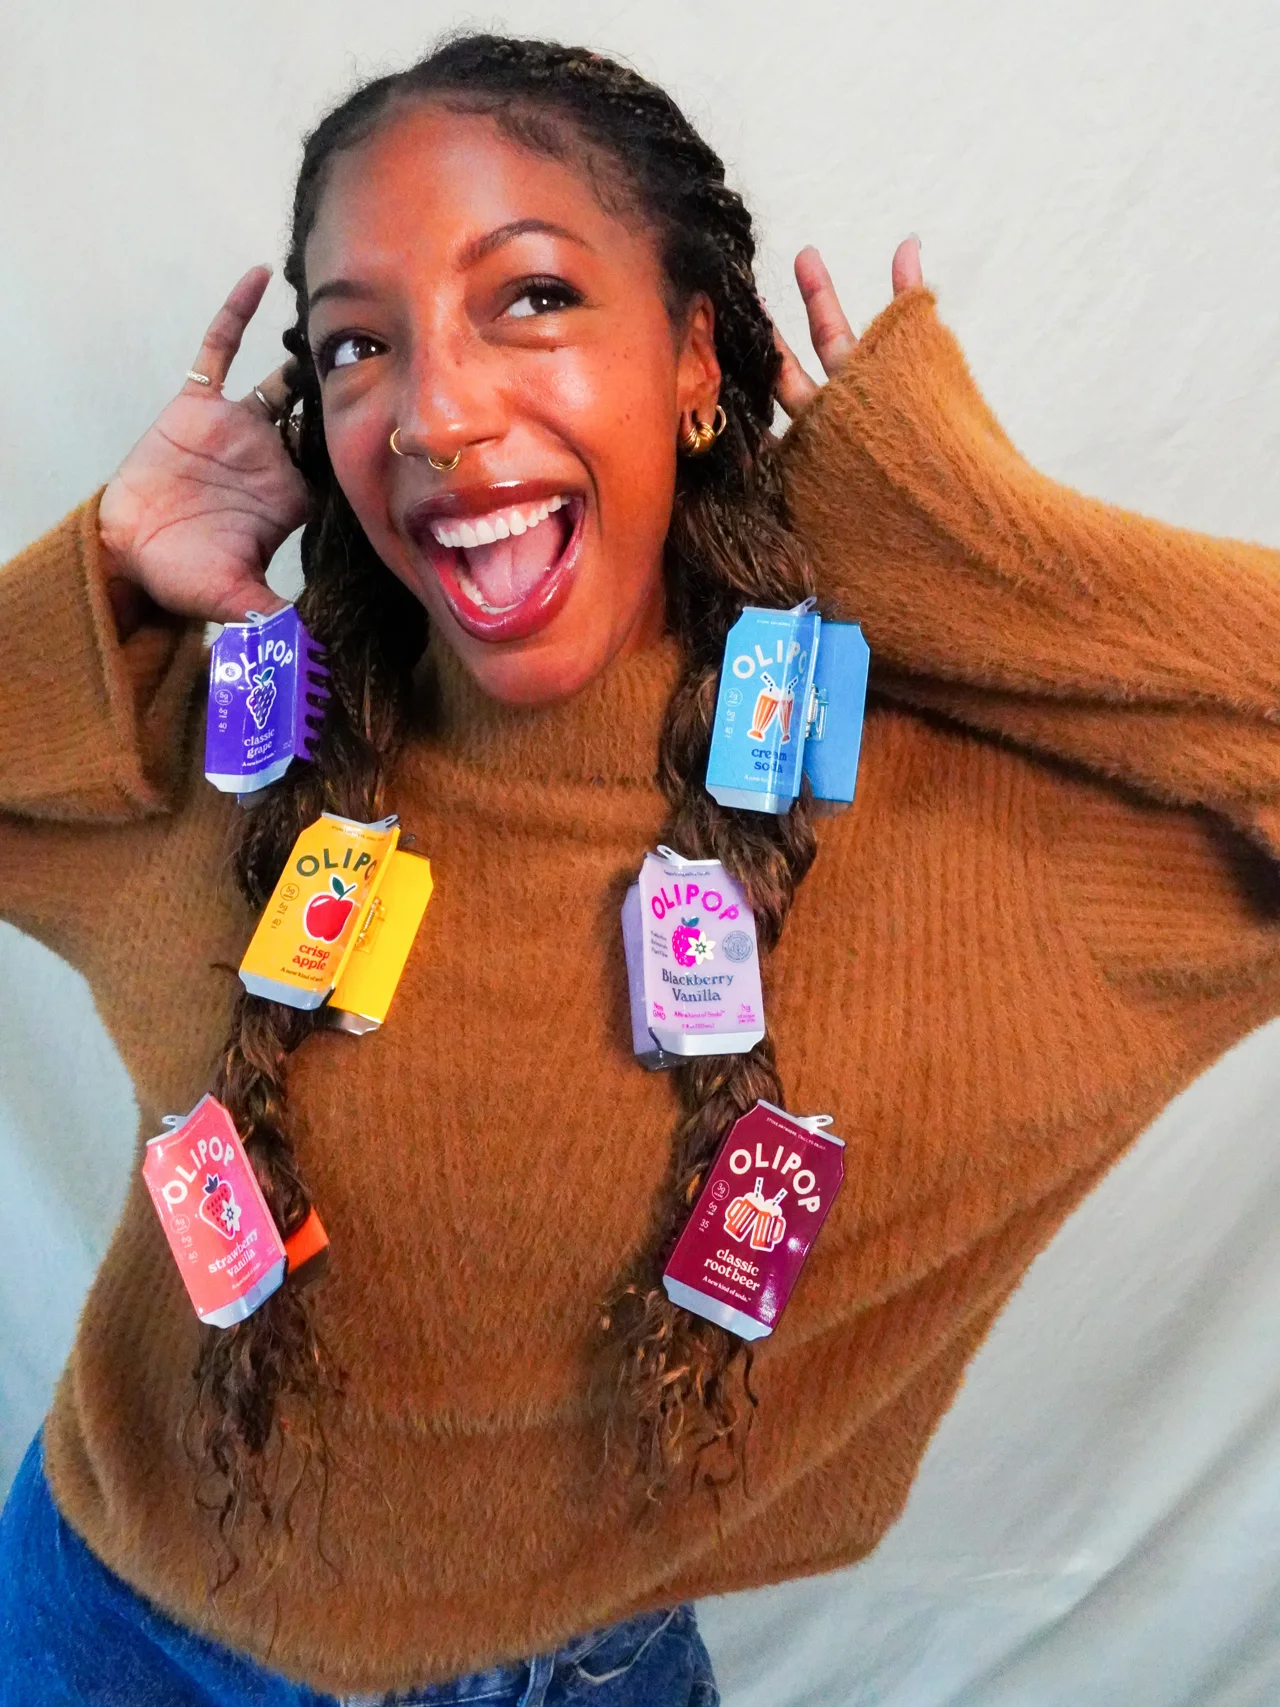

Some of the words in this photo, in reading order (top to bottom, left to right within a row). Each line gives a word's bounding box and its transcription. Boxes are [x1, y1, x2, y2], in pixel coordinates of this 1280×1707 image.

[732, 640, 808, 684] OLIPO
[243, 728, 275, 747] classic
[246, 741, 273, 759] grape
[296, 847, 378, 881] OLIPO
[651, 883, 740, 921] OLIPOP
[298, 943, 331, 960] crisp
[292, 954, 327, 971] apple
[661, 967, 734, 986] Blackberry
[672, 987, 722, 1002] Vanilla
[162, 1136, 235, 1205] OLIPOP
[729, 1142, 821, 1213] OLIPOP
[717, 1182, 726, 1195] 3g
[708, 1201, 718, 1213] 6g
[700, 1218, 709, 1229] 35
[207, 1228, 258, 1274] strawberry
[226, 1248, 256, 1278] vanilla
[716, 1249, 760, 1277] classic
[703, 1258, 732, 1278] root
[731, 1268, 761, 1292] beer
[708, 1278, 719, 1287] new
[718, 1281, 730, 1293] kind
